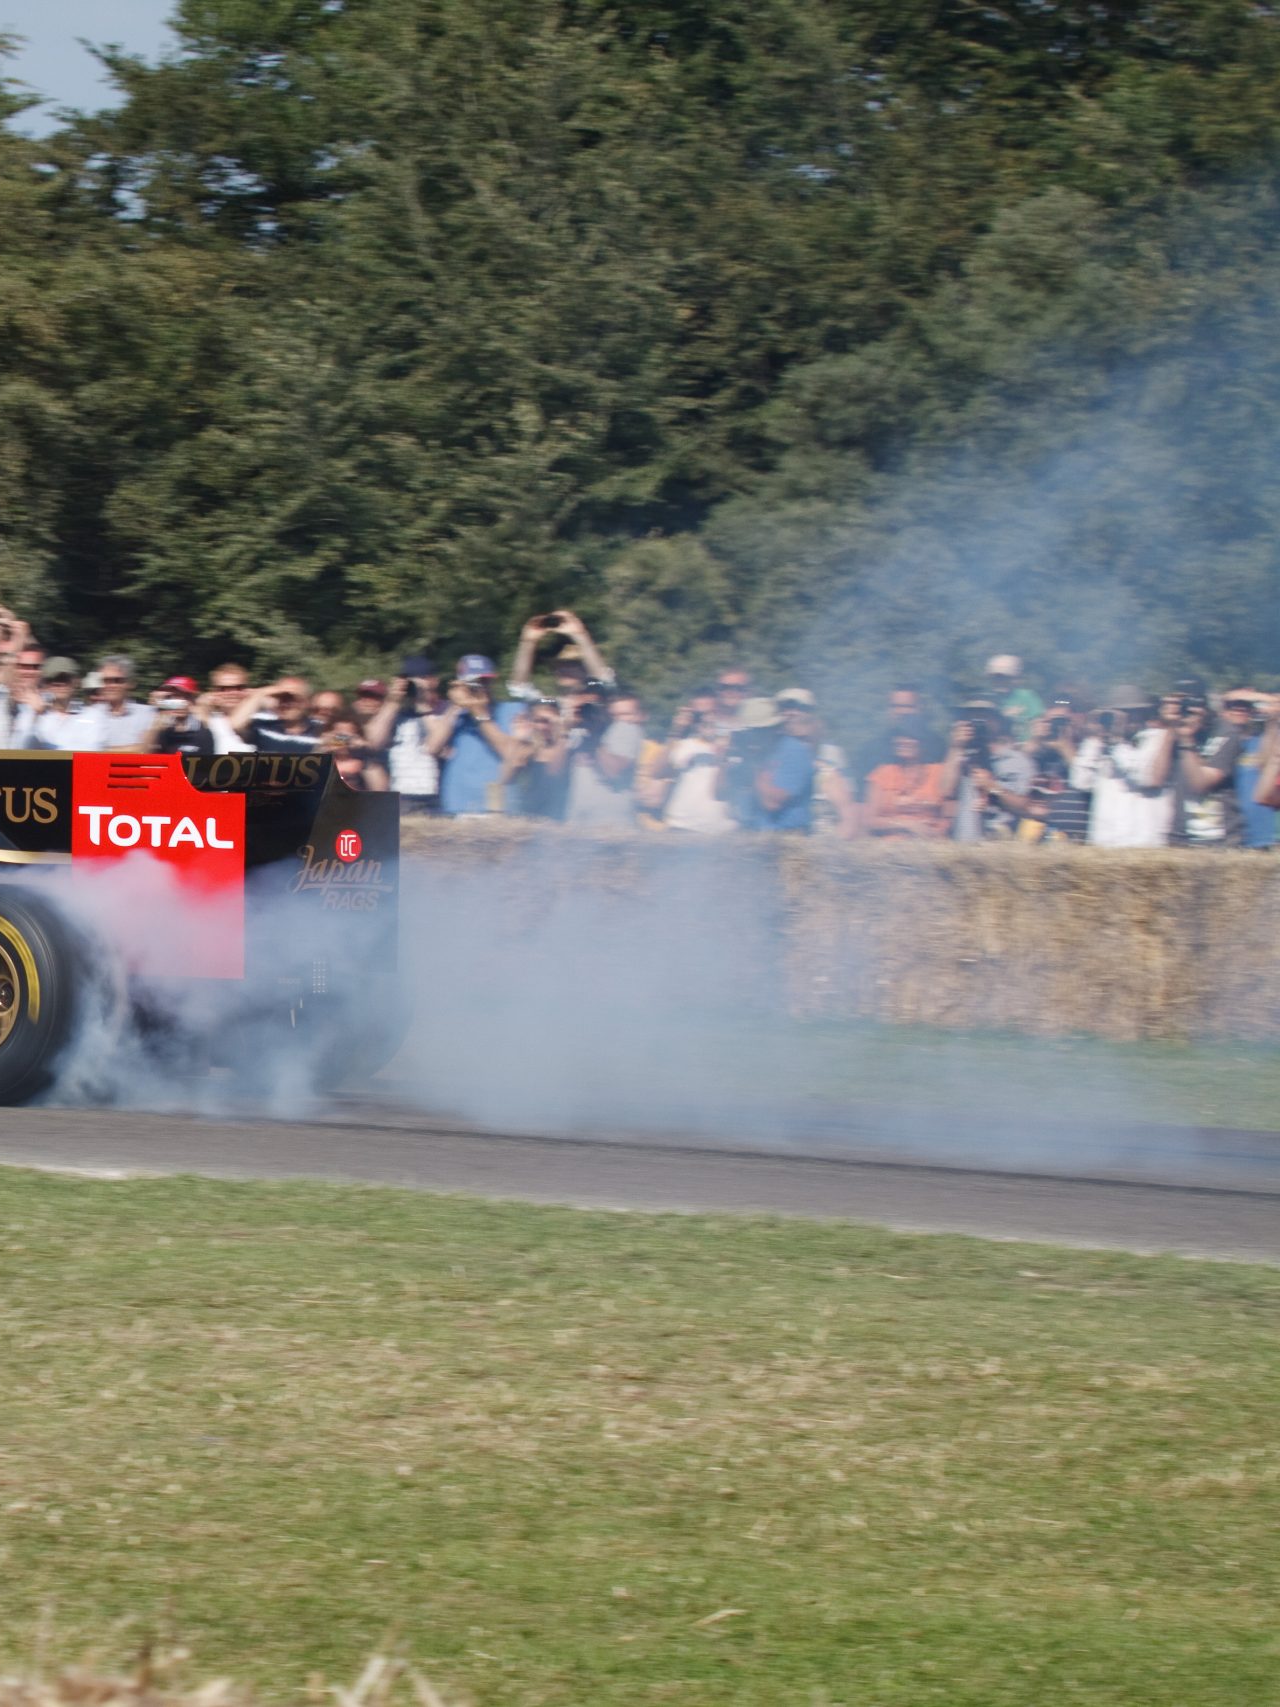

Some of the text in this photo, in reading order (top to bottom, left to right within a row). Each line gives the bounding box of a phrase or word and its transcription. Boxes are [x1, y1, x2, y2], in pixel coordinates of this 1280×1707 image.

[186, 755, 321, 788] LOTUS
[78, 805, 234, 849] TOTAL
[287, 845, 388, 895] Japan
